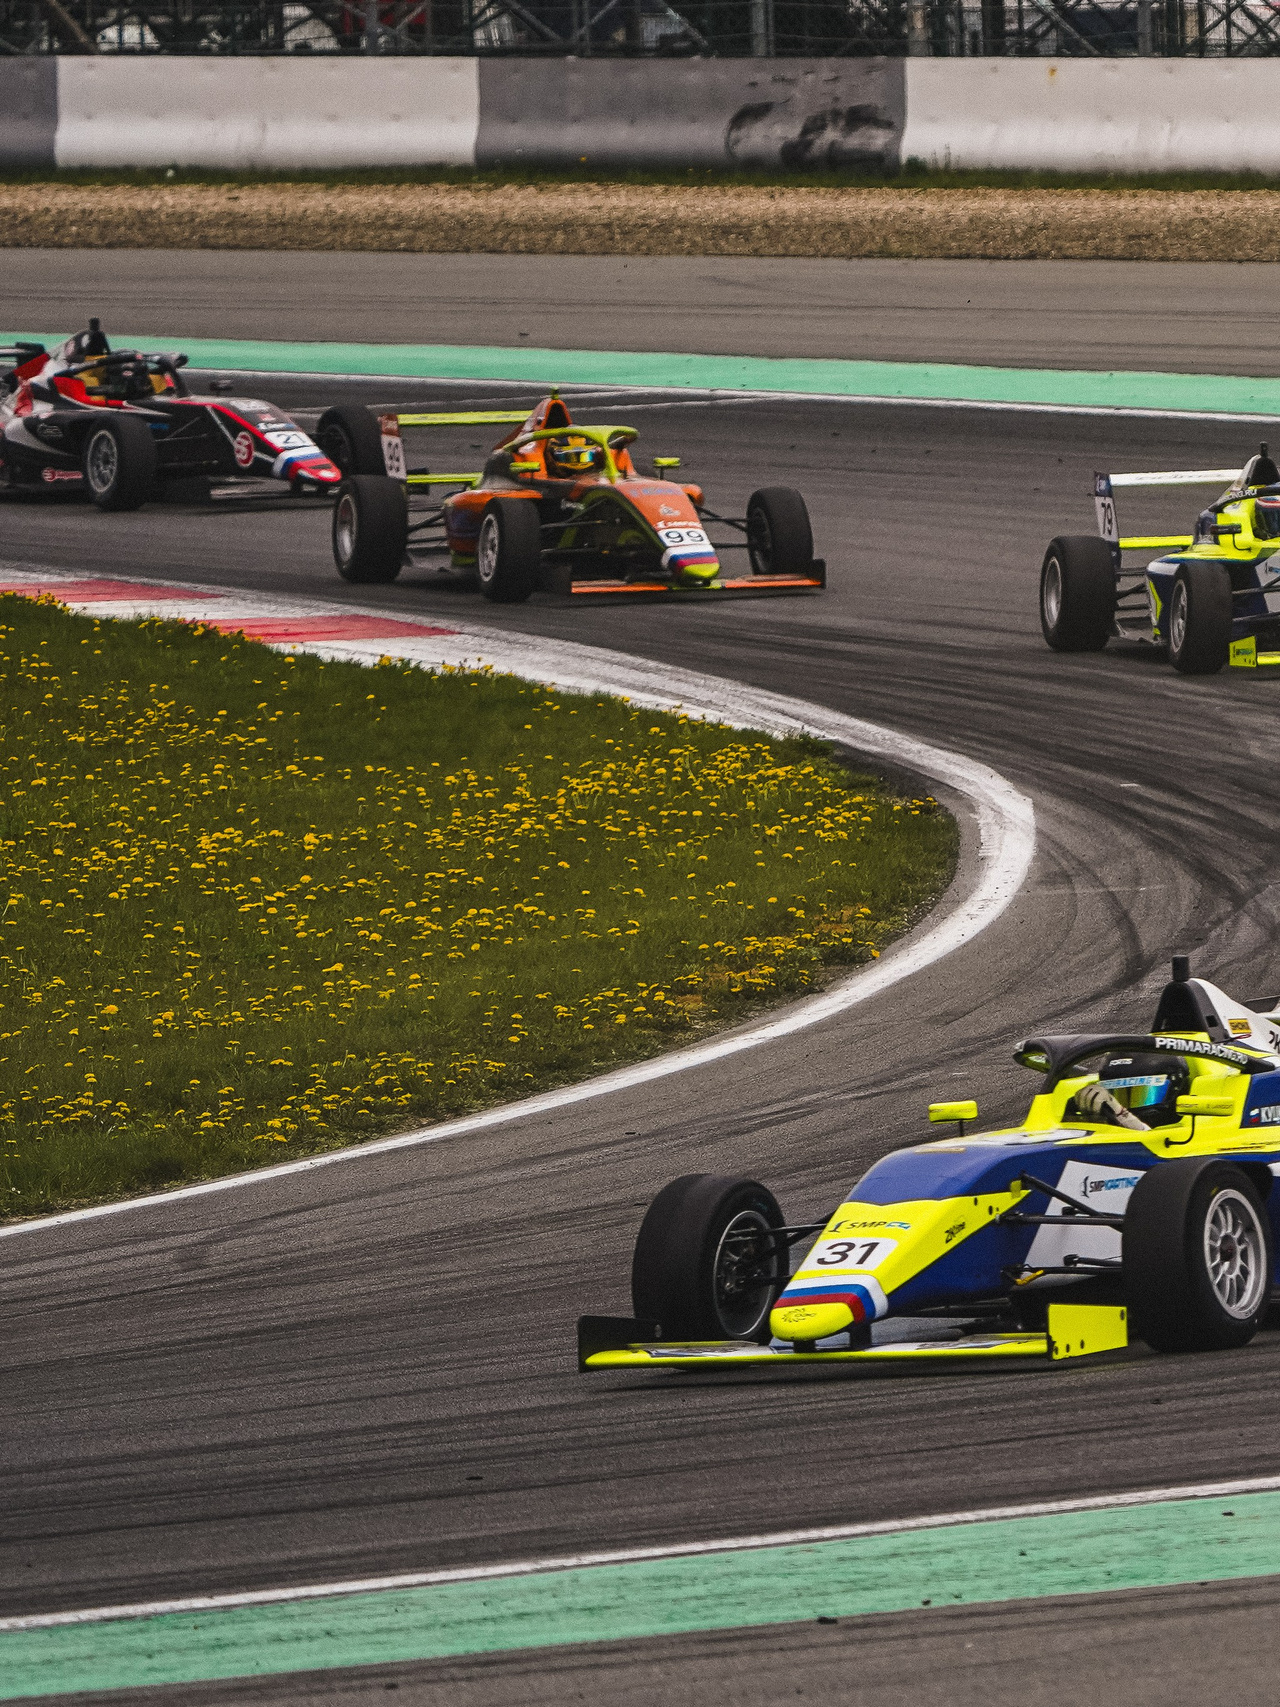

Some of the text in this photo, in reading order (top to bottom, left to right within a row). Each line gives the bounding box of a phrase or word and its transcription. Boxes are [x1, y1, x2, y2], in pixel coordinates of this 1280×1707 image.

[1101, 502, 1112, 535] 79
[665, 530, 704, 543] 99
[817, 1242, 880, 1265] 31
